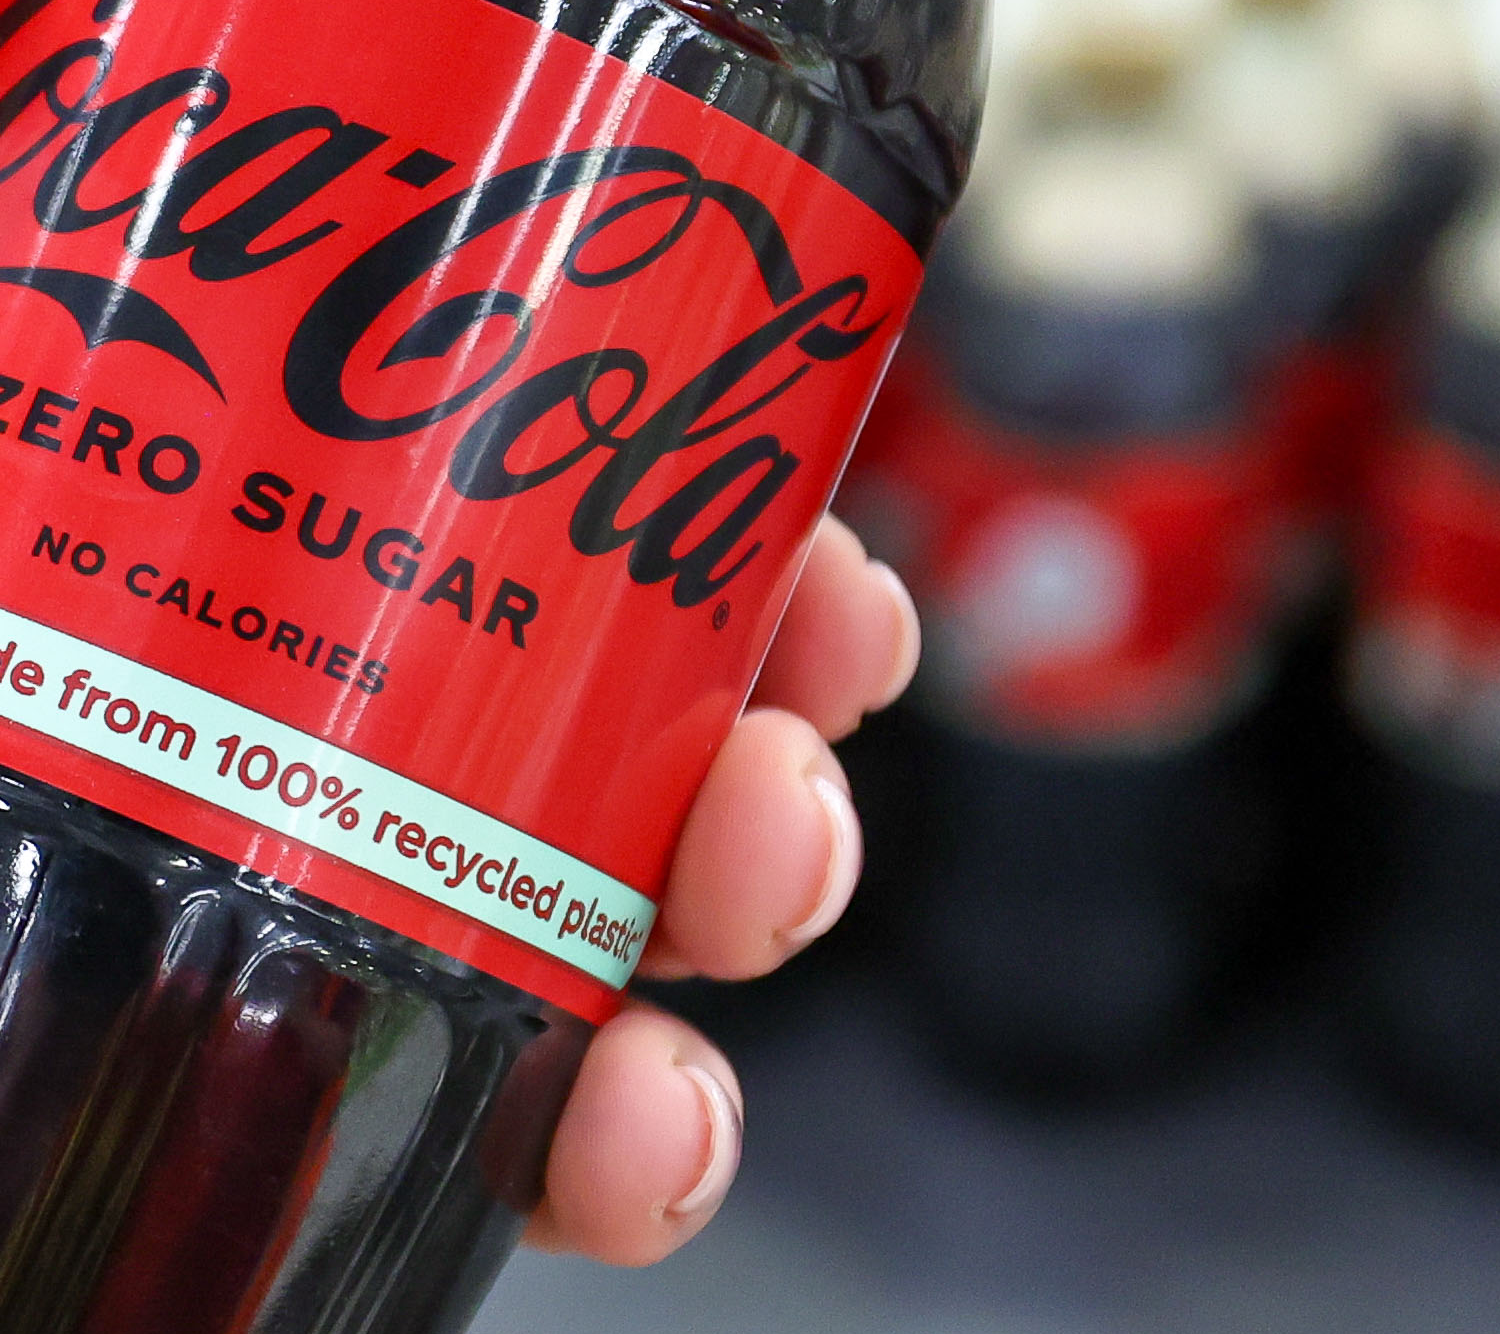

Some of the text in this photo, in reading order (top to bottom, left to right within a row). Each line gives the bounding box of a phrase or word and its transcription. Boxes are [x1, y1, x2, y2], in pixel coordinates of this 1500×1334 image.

[31, 525, 392, 695] NO CALORIES
[231, 472, 540, 649] SUGAR
[57, 669, 197, 761] from
[216, 735, 363, 831] 100%
[373, 810, 565, 921] recycled
